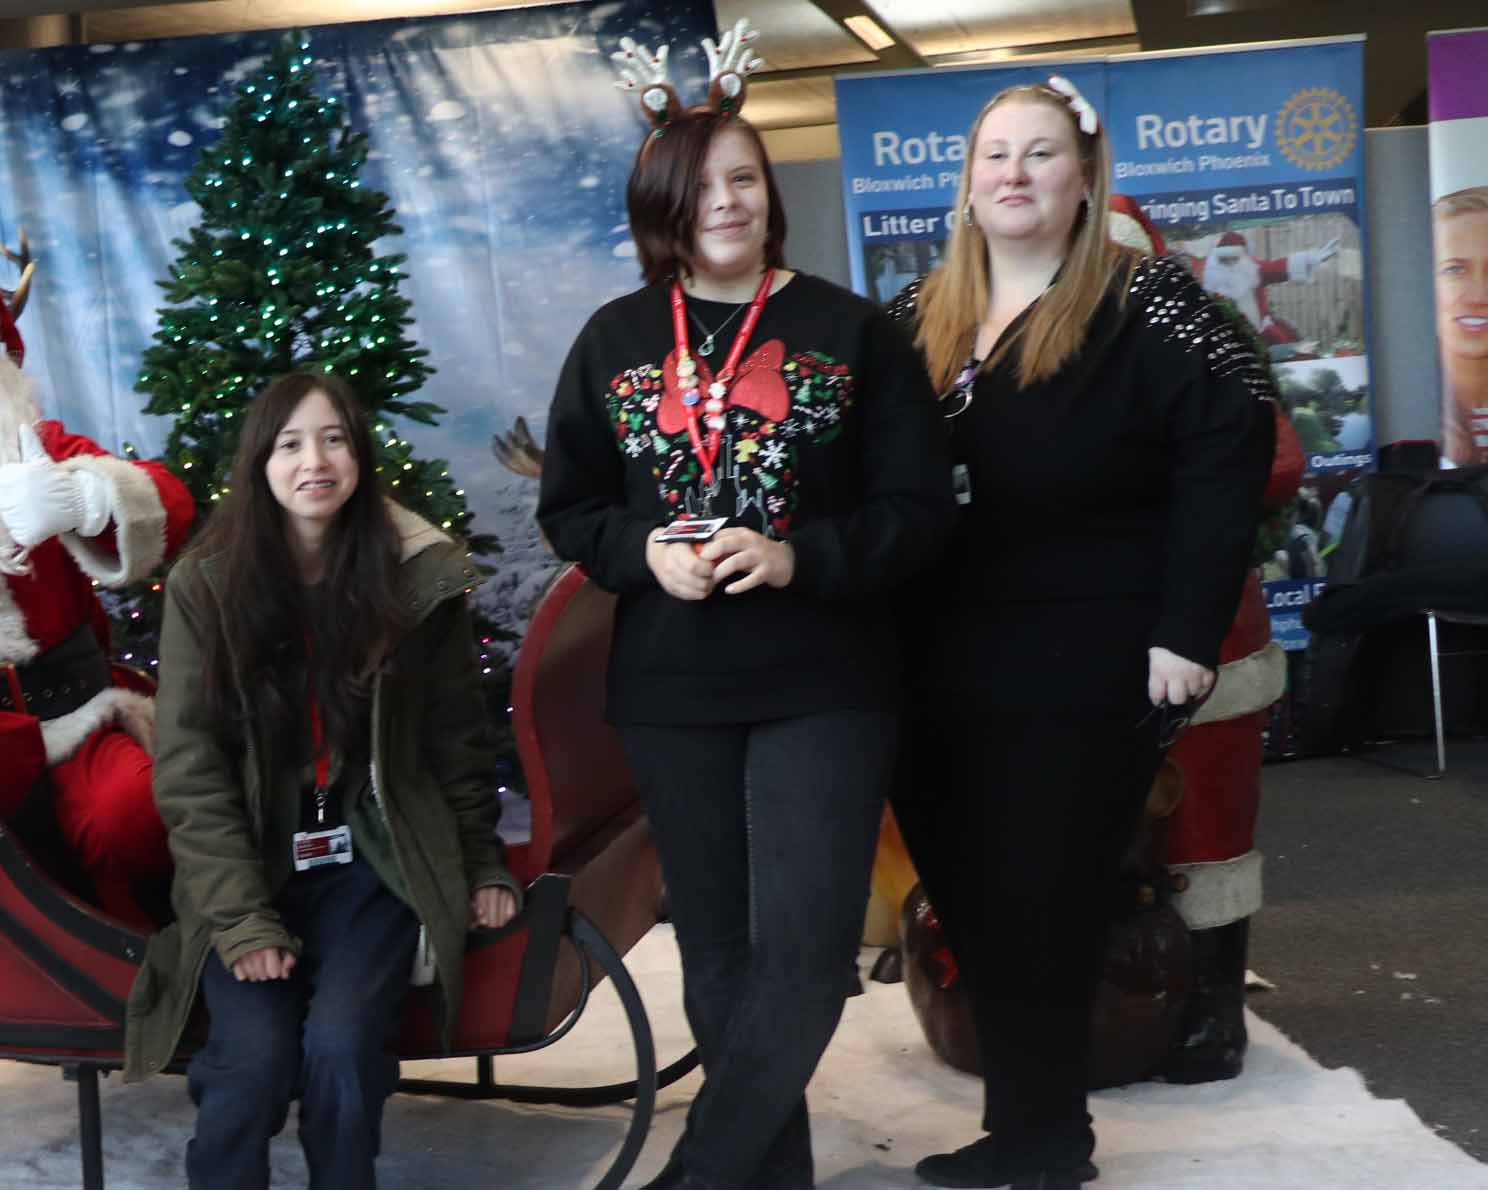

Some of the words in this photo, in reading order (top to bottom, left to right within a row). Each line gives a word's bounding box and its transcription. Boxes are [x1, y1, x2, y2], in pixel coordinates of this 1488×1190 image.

[1136, 113, 1269, 150] Rotary
[872, 131, 968, 167] Rota
[1114, 157, 1194, 178] Bloxwich
[1199, 153, 1272, 172] Phoenix
[852, 174, 935, 195] Bloxwich
[1141, 197, 1211, 223] ringing
[1213, 193, 1269, 215] Santa
[1270, 189, 1297, 211] To
[1298, 185, 1356, 207] Town
[863, 215, 940, 237] Litter
[1310, 453, 1373, 469] Outings
